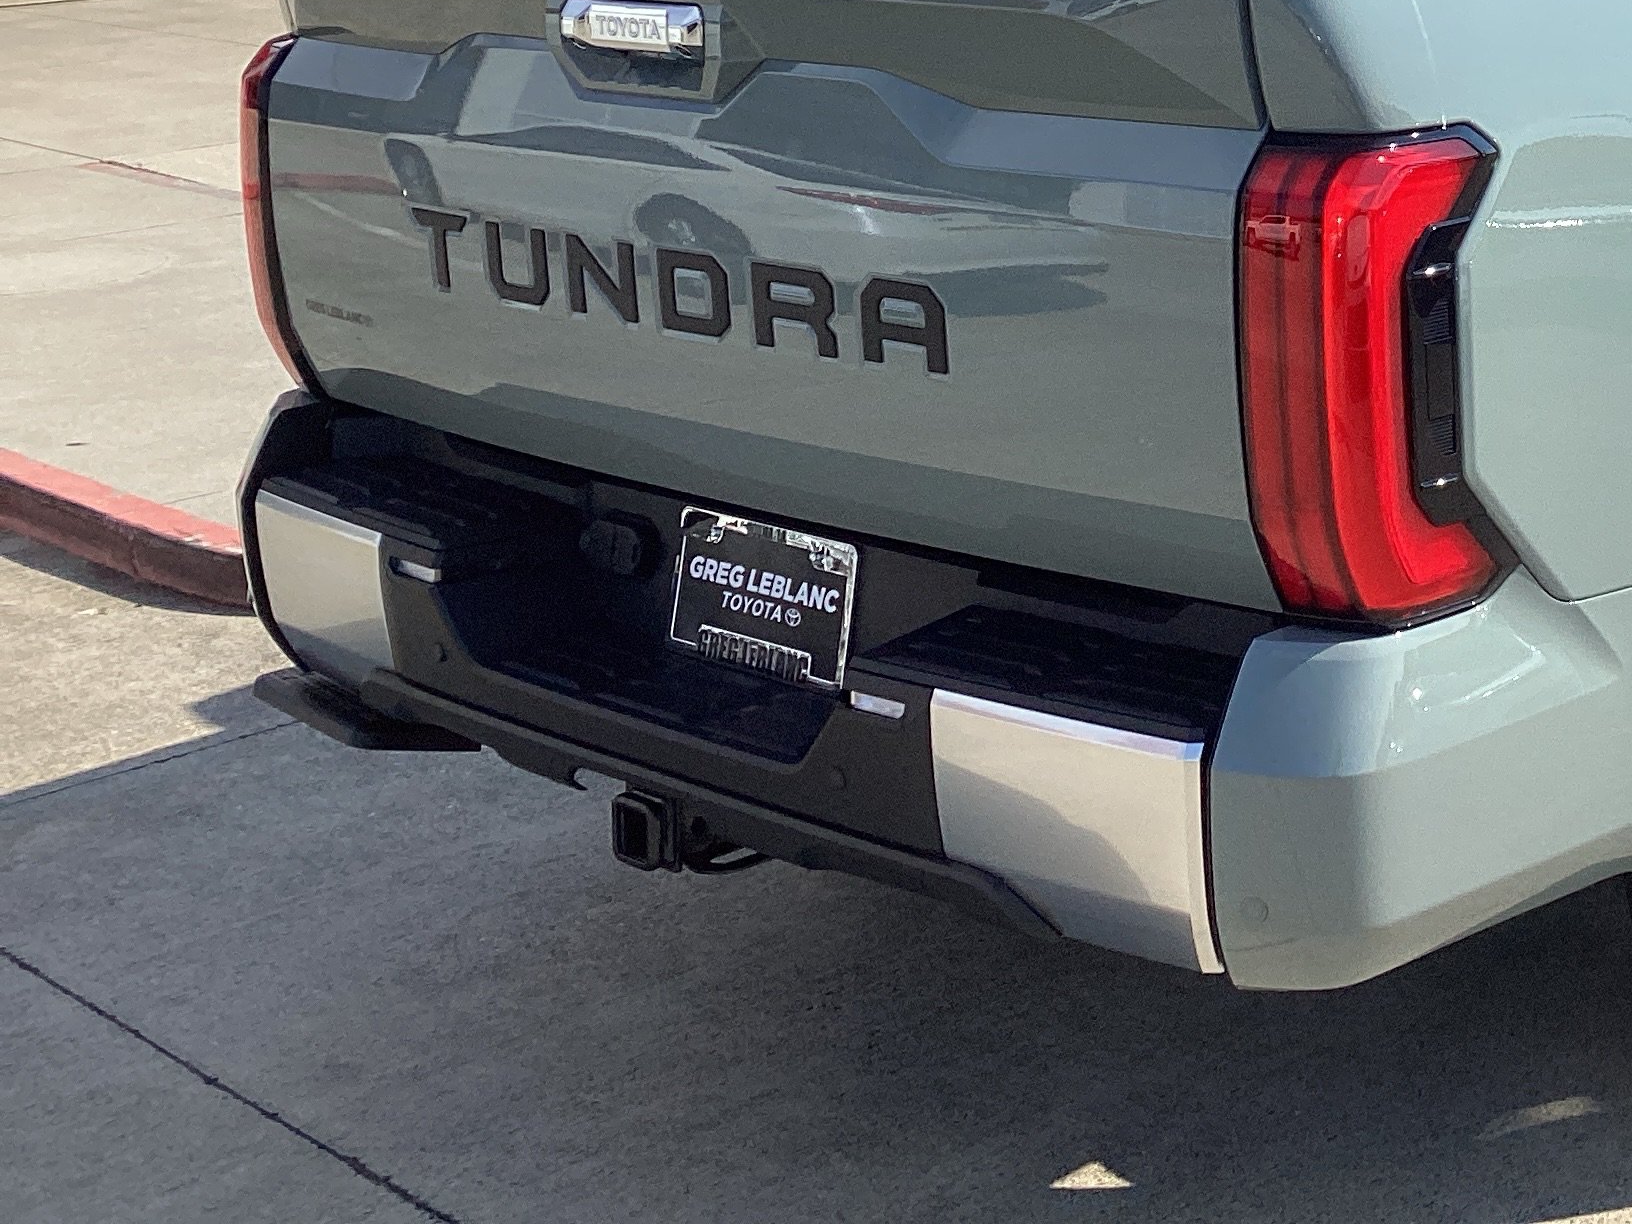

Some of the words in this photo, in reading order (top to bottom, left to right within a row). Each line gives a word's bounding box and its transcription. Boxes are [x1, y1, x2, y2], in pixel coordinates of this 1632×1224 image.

[595, 14, 662, 41] TOYOTA
[410, 207, 950, 376] TUNDRA
[689, 555, 745, 588] GREG
[746, 568, 840, 613] LEBLANC
[721, 590, 782, 623] TOYOTA
